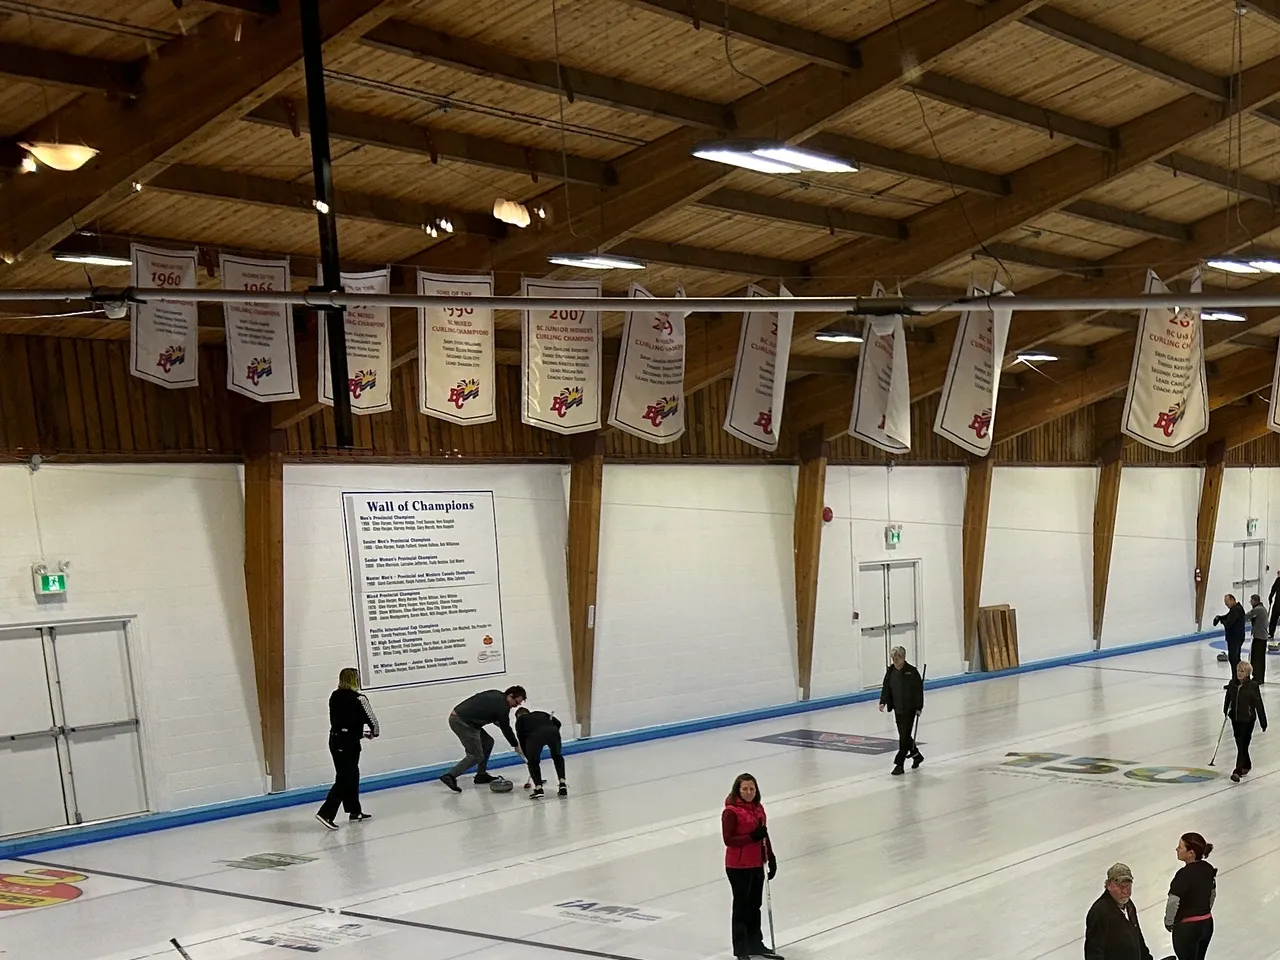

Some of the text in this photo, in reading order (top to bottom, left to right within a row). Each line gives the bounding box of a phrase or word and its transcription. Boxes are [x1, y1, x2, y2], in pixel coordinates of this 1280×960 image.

[151, 272, 181, 286] 1960
[548, 310, 586, 325] 2007
[367, 500, 475, 514] Wall of Champions
